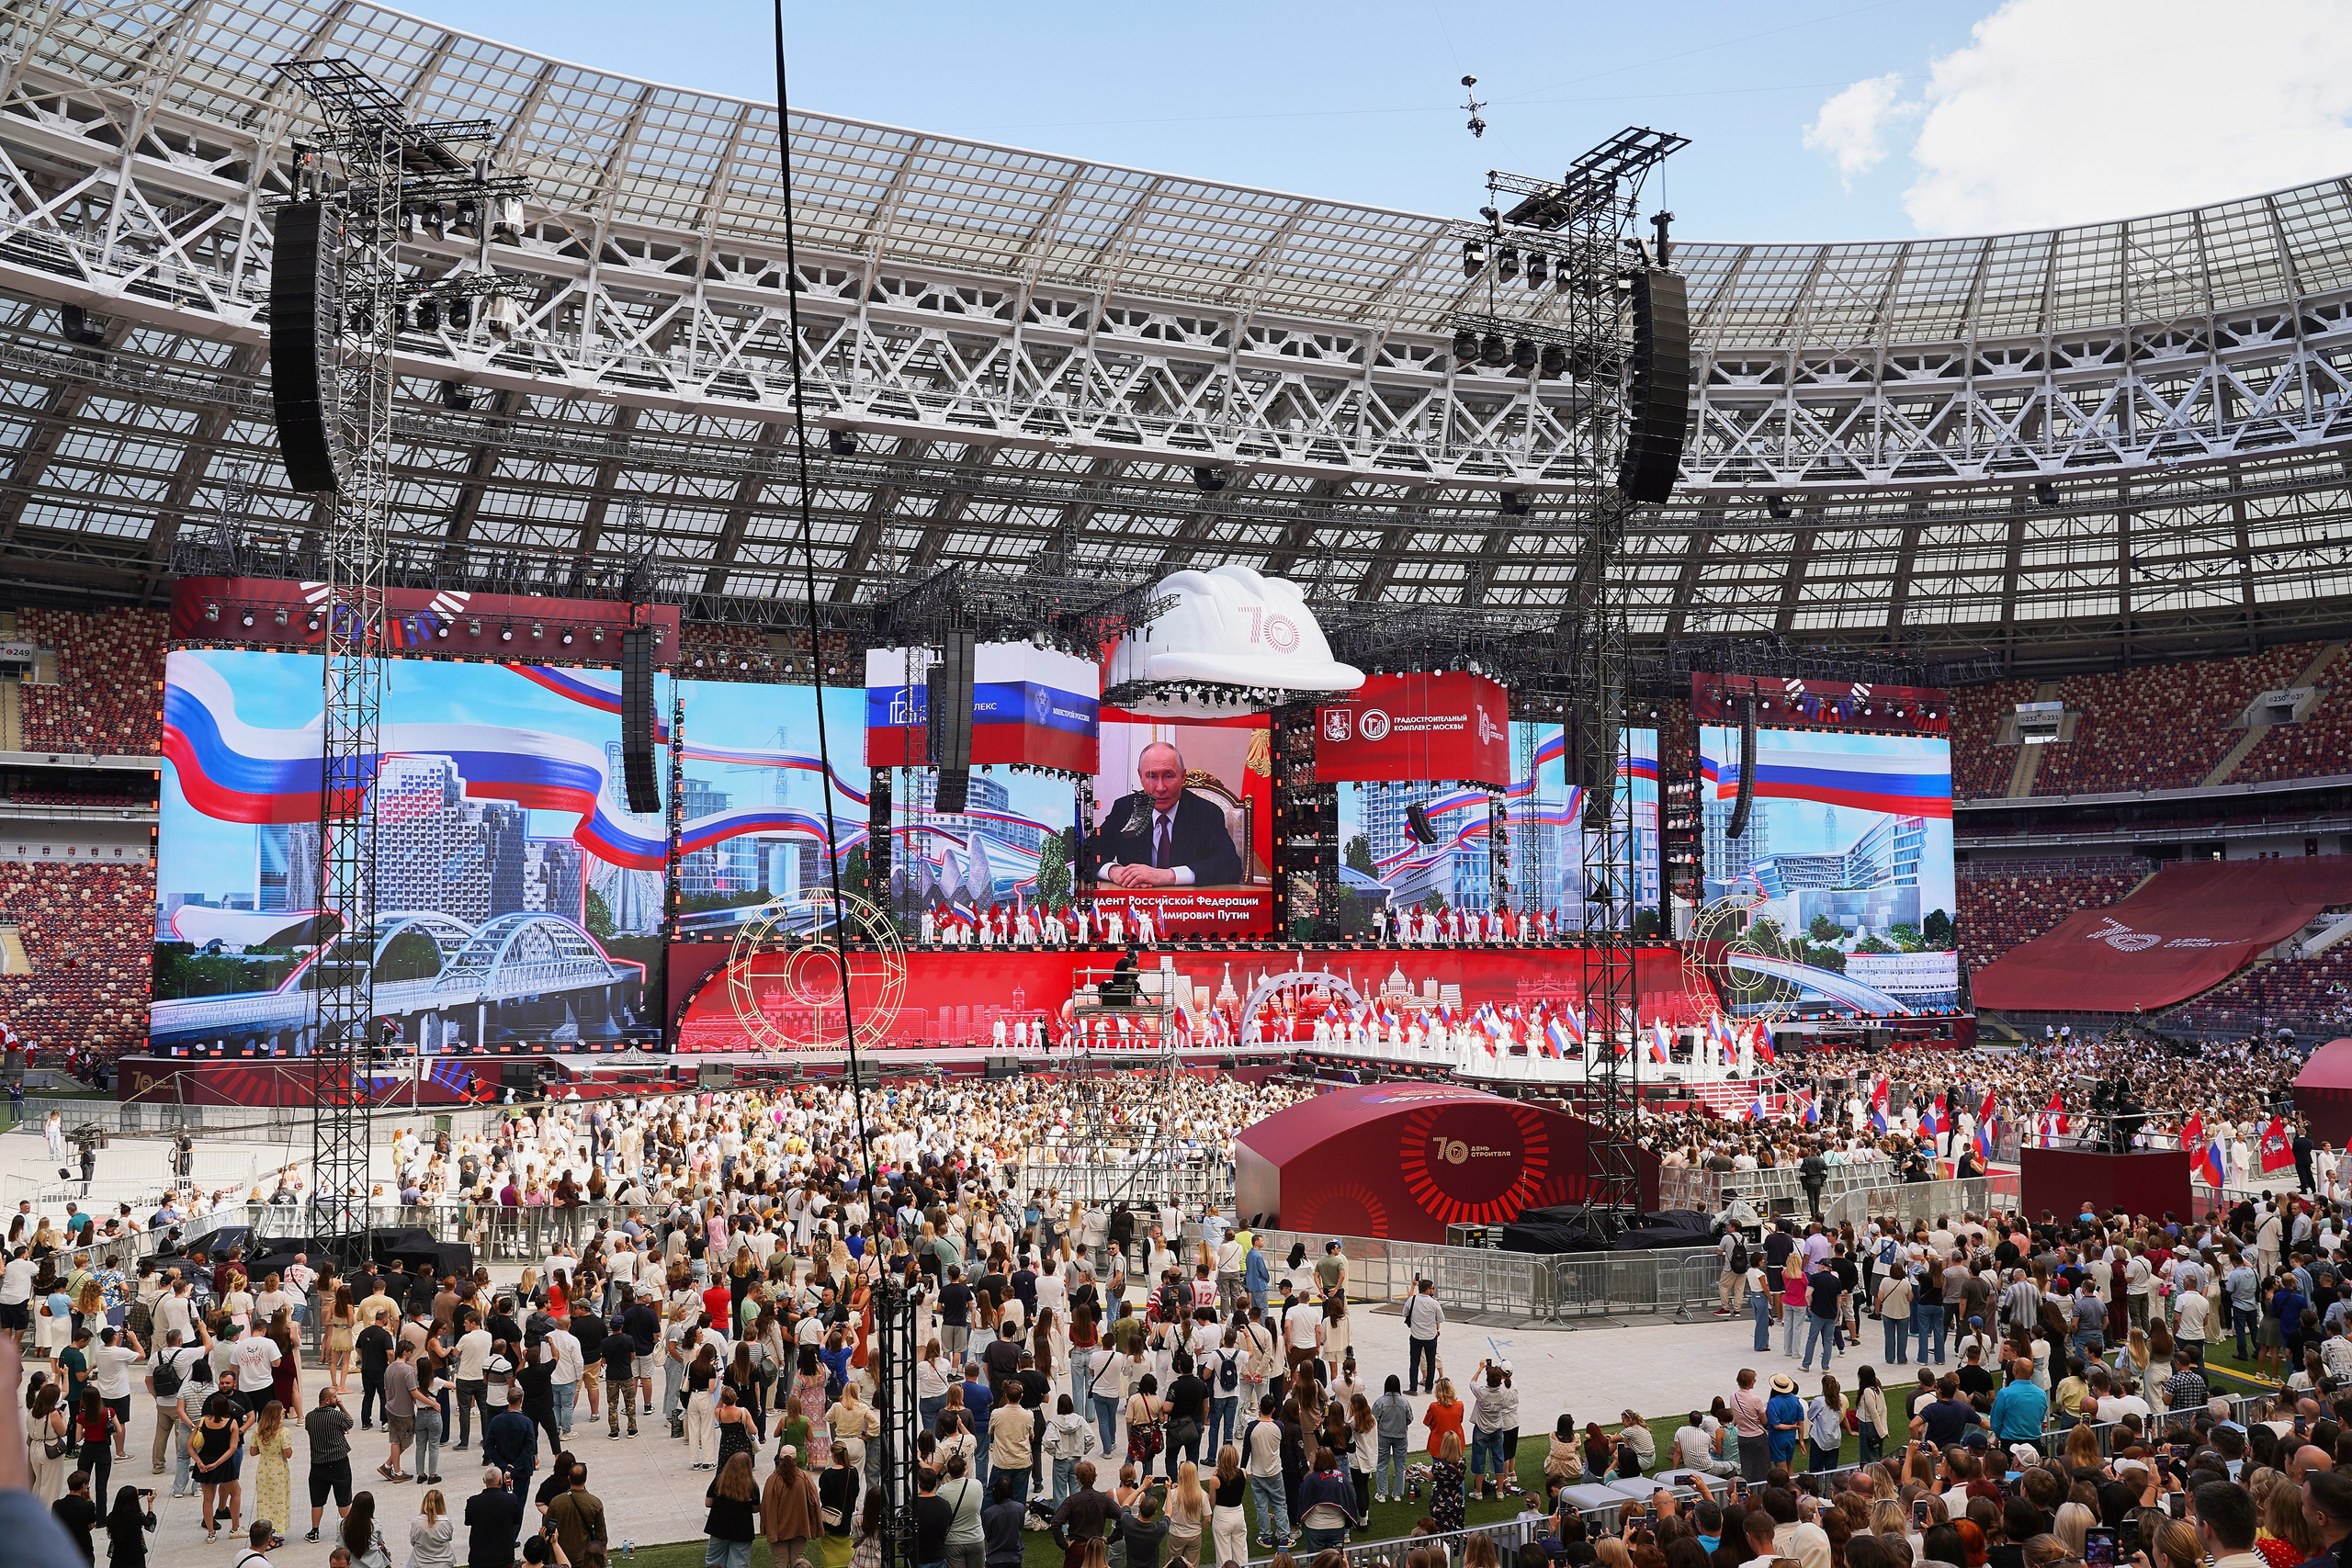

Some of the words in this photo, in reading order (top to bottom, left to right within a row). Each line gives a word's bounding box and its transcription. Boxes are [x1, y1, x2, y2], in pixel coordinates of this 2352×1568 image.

[1394, 714, 1467, 724] ГРАДОСТРОИТЕЛЬНЫЙ
[1128, 895, 1193, 906] Российской
[1196, 896, 1259, 907] Федерации
[1217, 909, 1250, 919] Путин
[131, 1071, 153, 1094] 70
[1433, 1137, 1469, 1165] 70
[1198, 1292, 1212, 1305] 12
